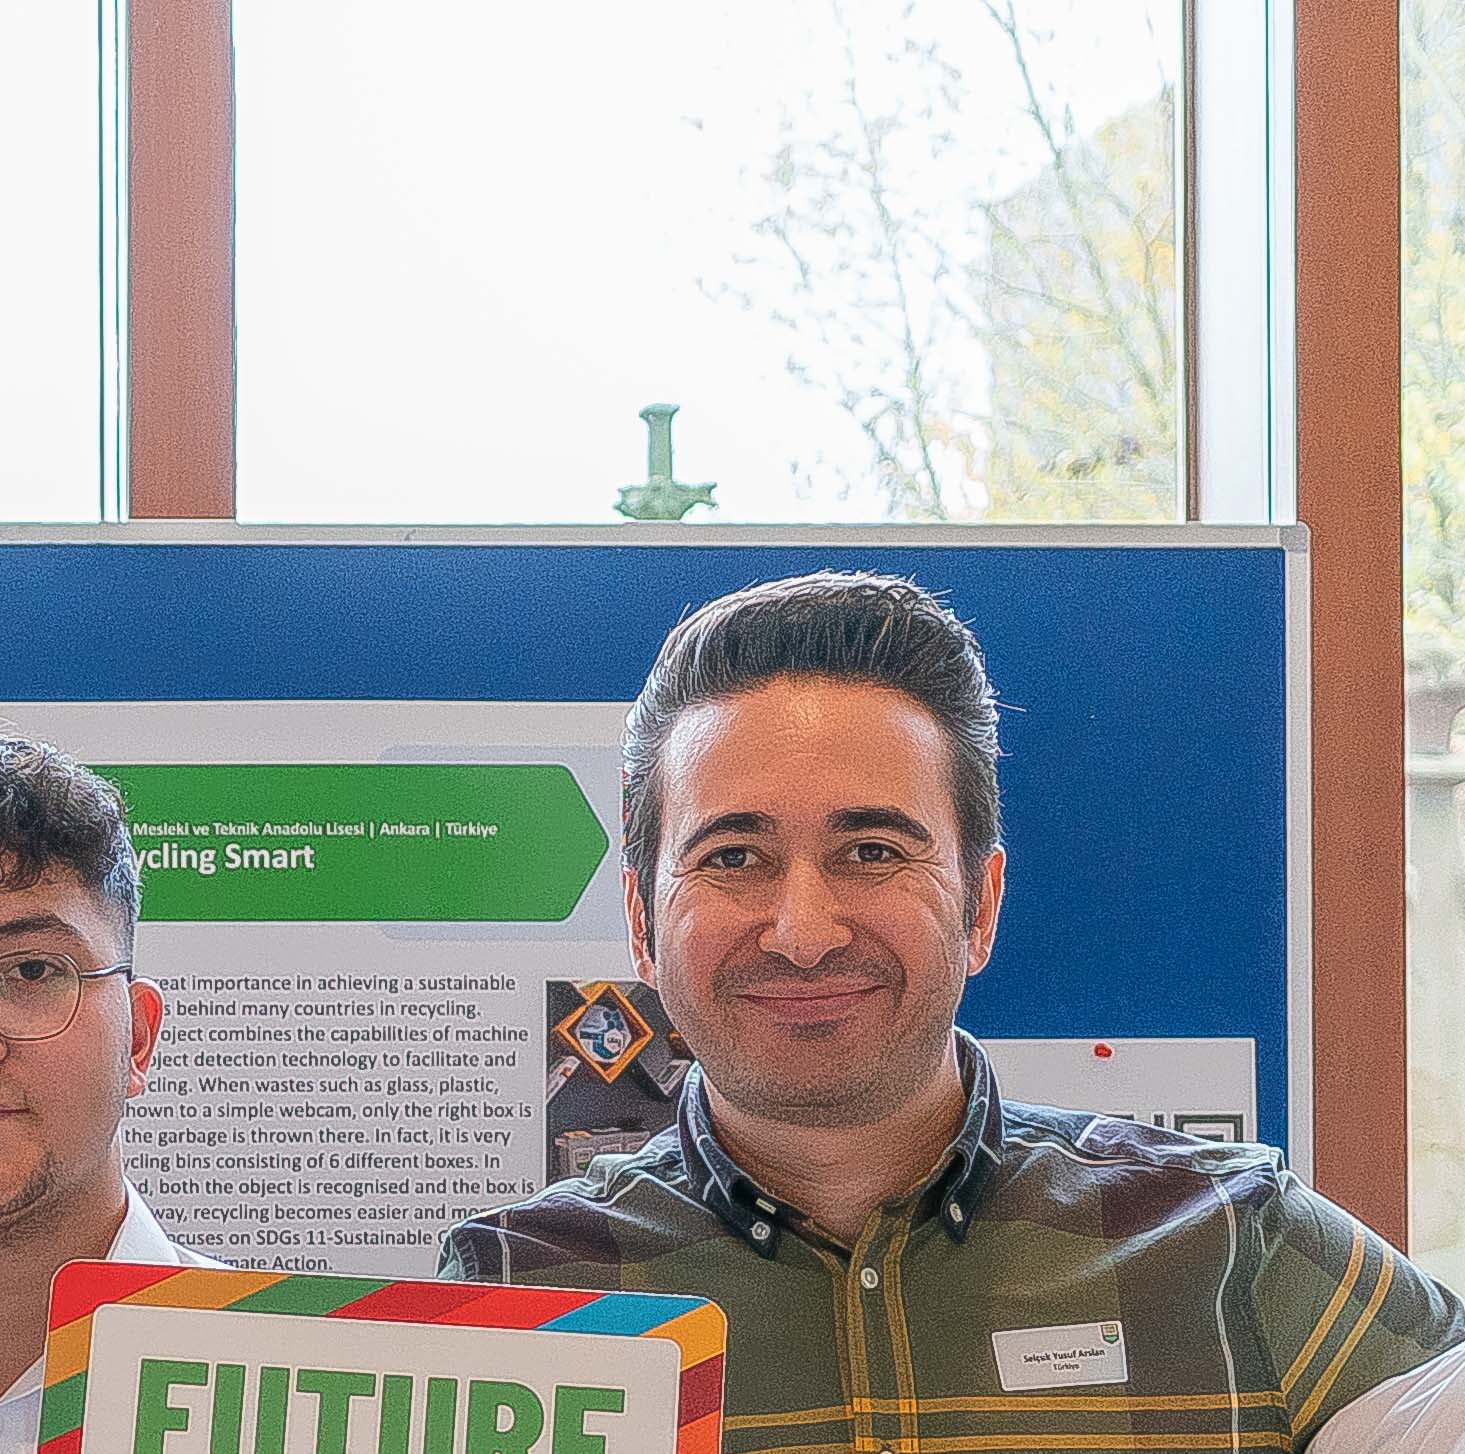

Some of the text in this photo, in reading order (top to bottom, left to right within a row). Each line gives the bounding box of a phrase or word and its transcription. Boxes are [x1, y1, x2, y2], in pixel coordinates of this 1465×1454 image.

[133, 822, 189, 837] Mesleki
[192, 825, 210, 837] ve
[212, 822, 259, 837] Teknik
[262, 822, 323, 837] Anadolu
[326, 822, 365, 837] Lisesi
[379, 822, 430, 837] Ankara
[444, 822, 499, 840] Türkiye
[132, 842, 316, 875] ycling Smart
[155, 974, 516, 994] eat importance in achieving a sustainable
[177, 1000, 236, 1016] behind
[242, 1004, 289, 1019] many
[294, 1001, 375, 1016] countries
[380, 1000, 395, 1016] in
[401, 1000, 481, 1020] recycling.
[160, 1025, 529, 1045] oject combines the capabilities of machine
[151, 1050, 516, 1071] ject detection technology to facilitate and
[144, 1076, 498, 1096] cling. When wastes such as glass, plastic,
[123, 1102, 532, 1122] hown to a simple webcam, only the right box is
[125, 1127, 511, 1147] the garbage is thrown there. In fact, it is very
[124, 1152, 500, 1173] ycling bins consisting of 6 different boxes. In
[159, 1178, 200, 1194] both
[205, 1179, 234, 1195] the
[238, 1178, 293, 1198] object
[298, 1179, 311, 1194] is
[316, 1178, 410, 1198] recognised
[414, 1178, 447, 1194] and
[452, 1178, 481, 1194] the
[486, 1178, 517, 1194] box
[521, 1178, 535, 1194] is
[193, 1204, 270, 1224] recycling
[274, 1204, 352, 1220] becomes
[357, 1204, 409, 1220] easier
[414, 1203, 446, 1220] and
[168, 1233, 224, 1246] ocuses
[228, 1233, 251, 1245] on
[256, 1229, 301, 1246] SDGs
[307, 1229, 433, 1246] 11-Sustainable
[271, 1255, 333, 1271] Action.
[1053, 1349, 1077, 1360] Yusuf
